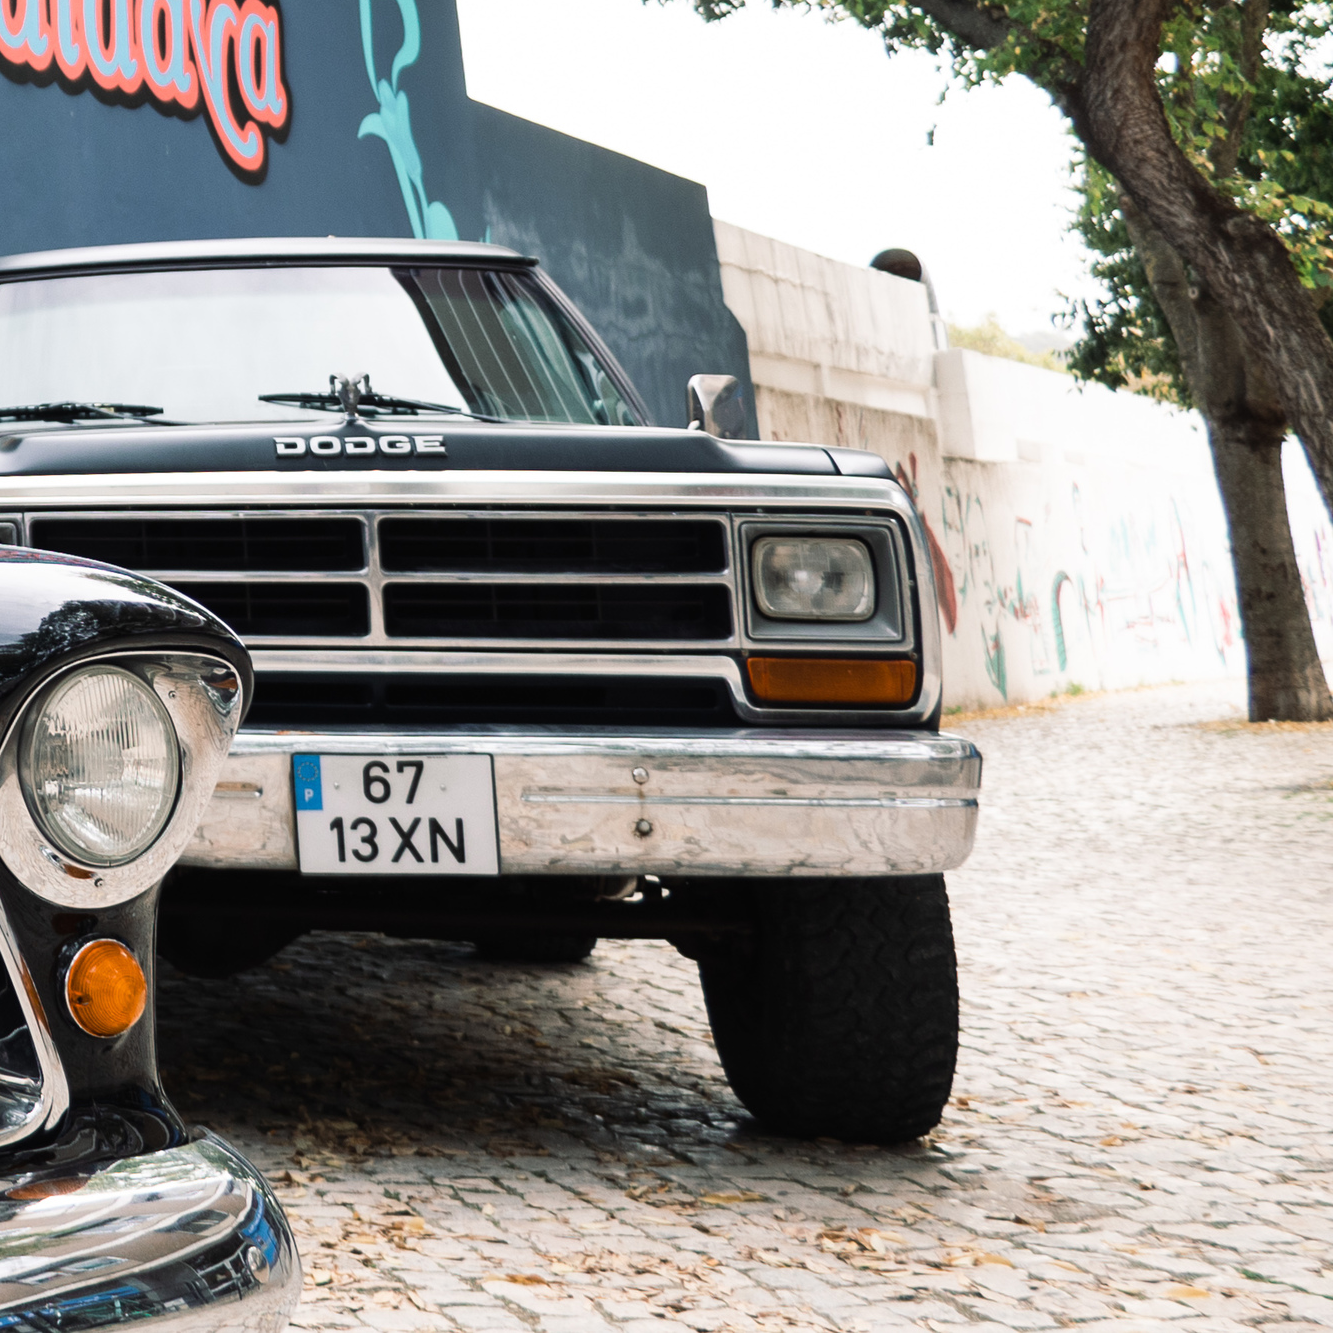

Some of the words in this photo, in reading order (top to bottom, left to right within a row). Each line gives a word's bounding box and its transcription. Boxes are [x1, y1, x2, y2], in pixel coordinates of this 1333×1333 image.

[273, 435, 448, 458] DODGE
[362, 759, 425, 805] 67
[303, 787, 314, 803] P
